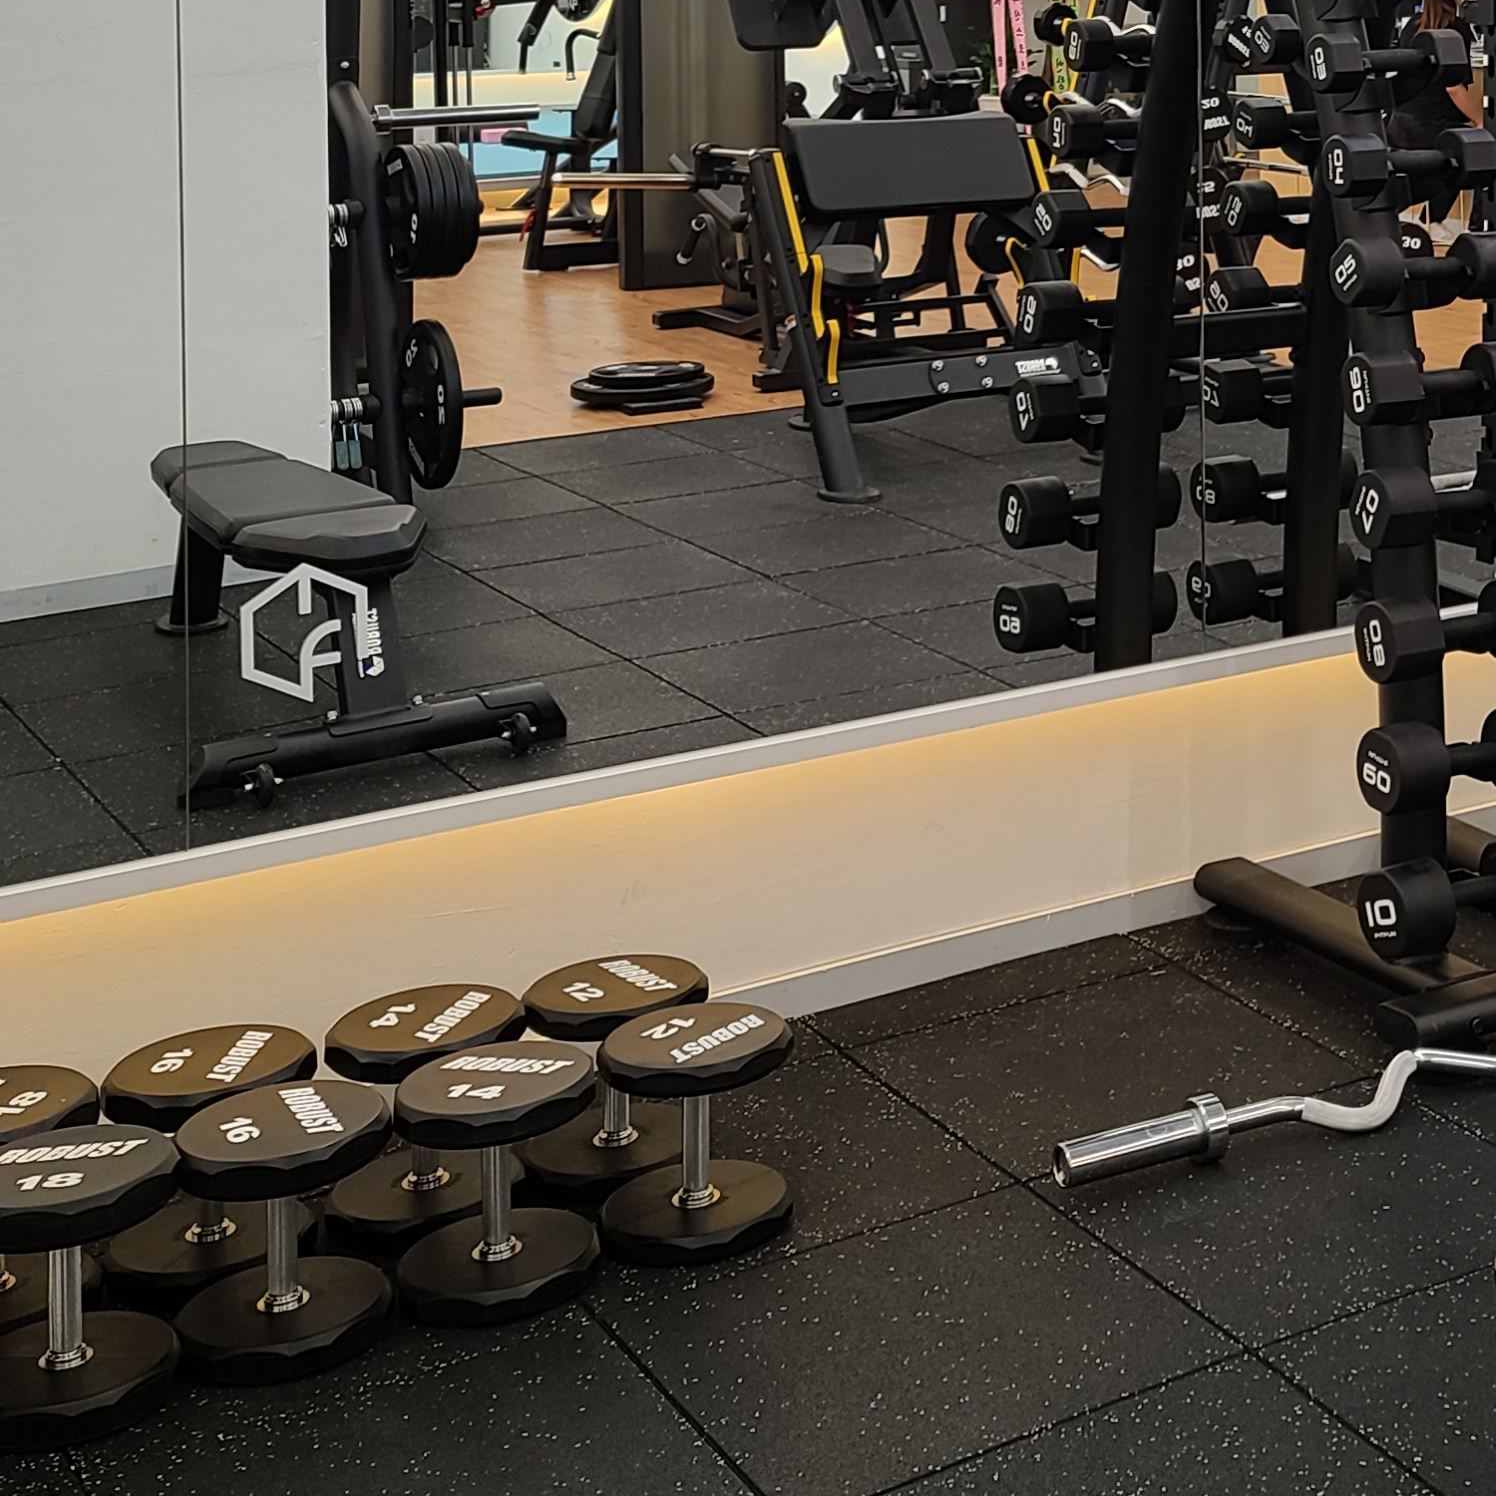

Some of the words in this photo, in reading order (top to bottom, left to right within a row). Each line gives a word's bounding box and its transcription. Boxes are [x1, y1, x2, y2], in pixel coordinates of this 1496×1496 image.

[598, 959, 678, 991] ROBUST
[562, 981, 605, 1002] 12
[414, 990, 492, 1043] ROBUST
[639, 1017, 696, 1039] 12
[669, 1014, 765, 1064] ROBUST
[205, 1030, 274, 1083] ROBUST
[440, 1055, 575, 1074] ROBUST
[447, 1083, 506, 1099] 14
[278, 1086, 344, 1133] ROBUST
[219, 1117, 262, 1144] 16
[0, 1137, 150, 1165] ROBUST
[15, 1172, 85, 1192] 18
